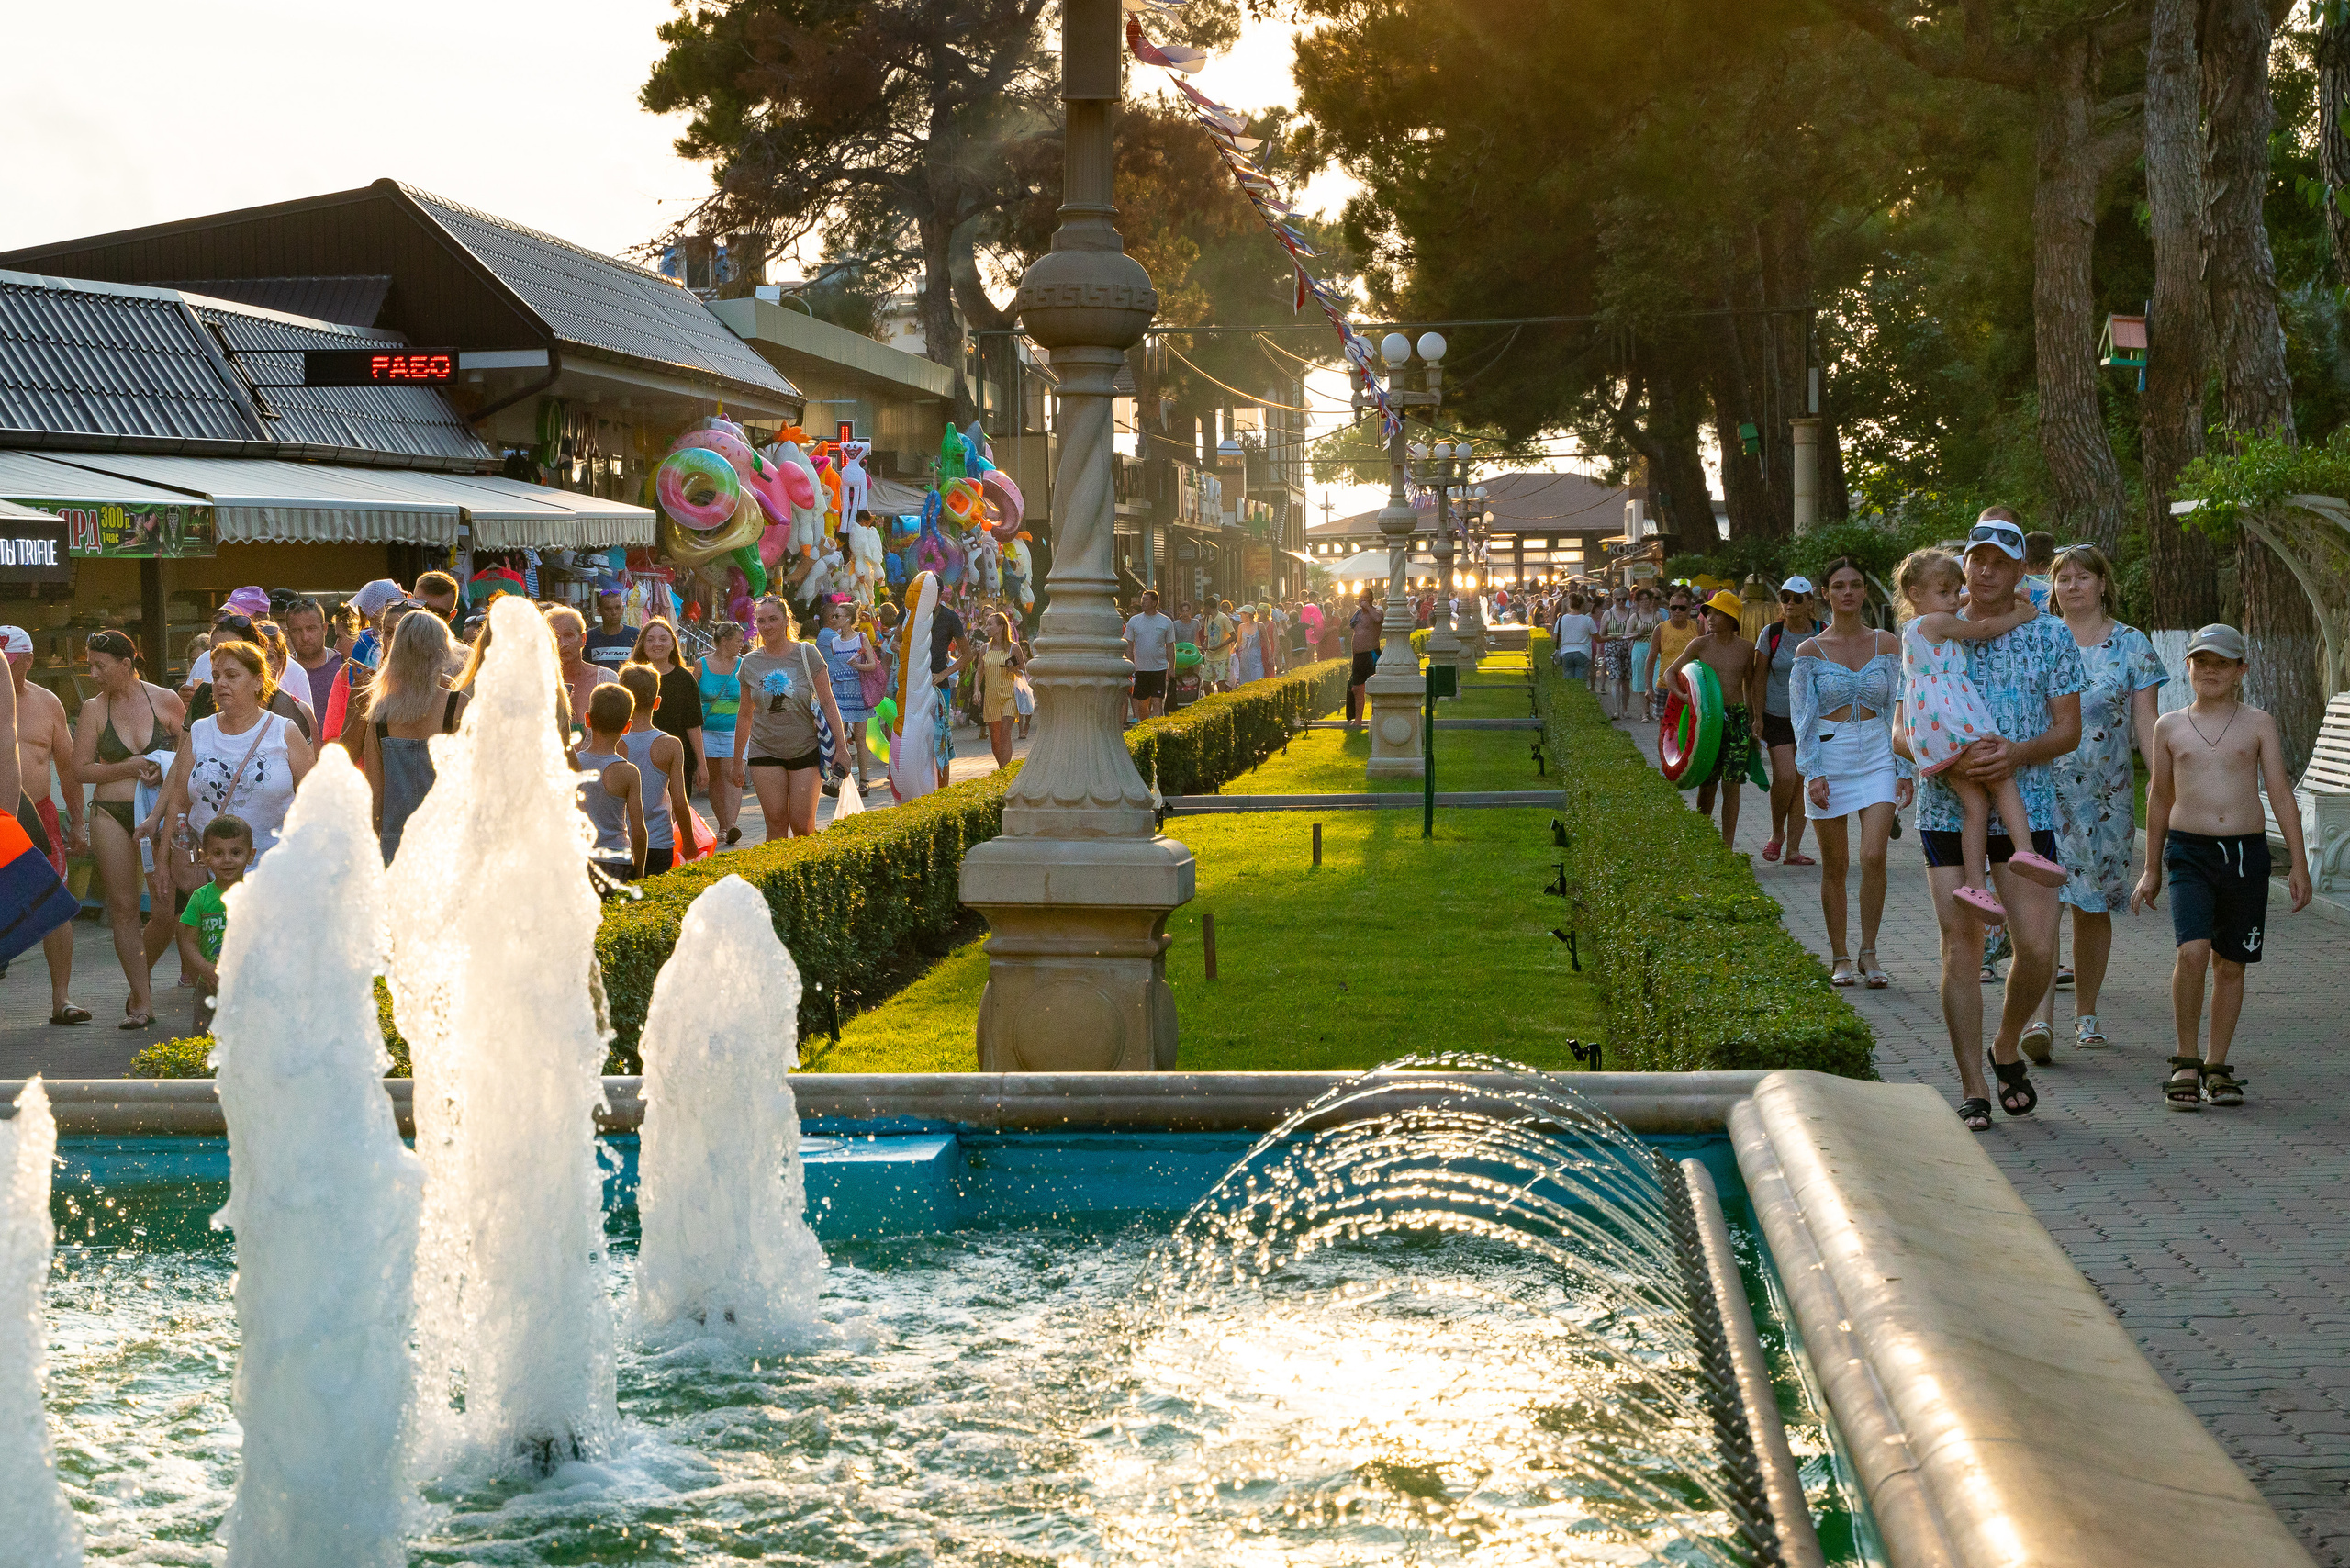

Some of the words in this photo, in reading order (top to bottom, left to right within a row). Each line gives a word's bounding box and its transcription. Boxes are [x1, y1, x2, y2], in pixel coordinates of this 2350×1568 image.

[101, 506, 124, 529] 300
[102, 531, 106, 543] 1
[106, 532, 119, 543] час
[16, 538, 59, 566] TRIFLE
